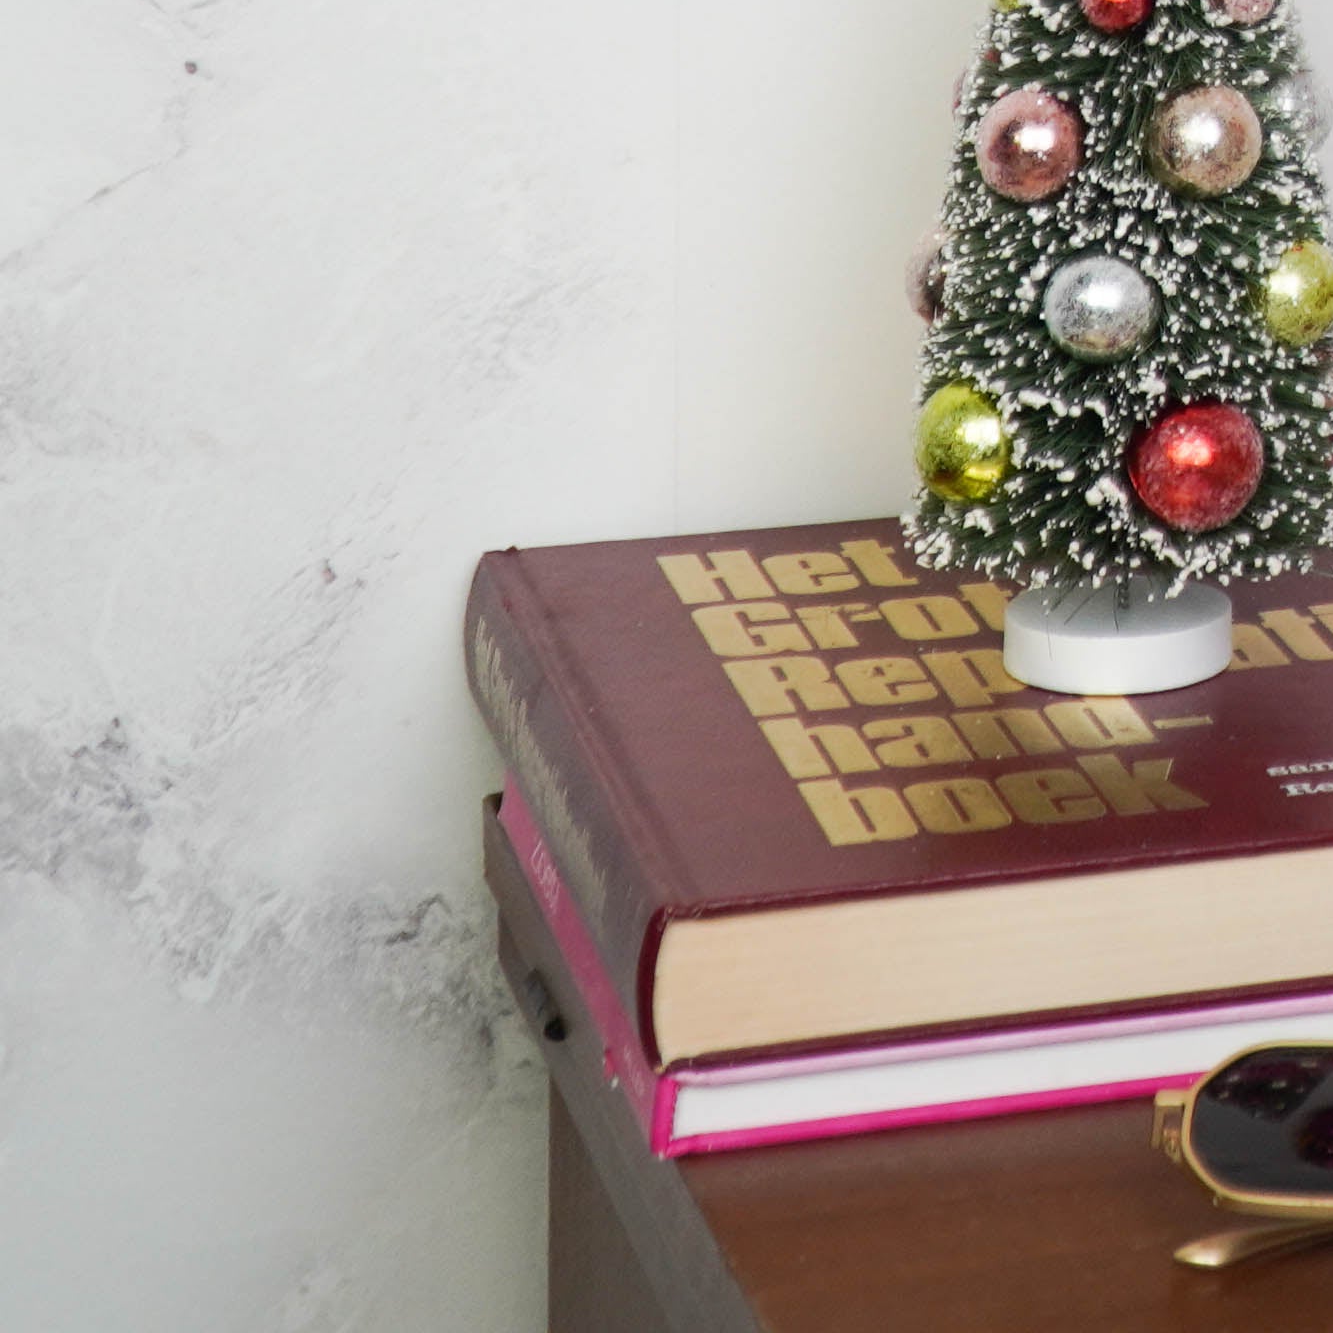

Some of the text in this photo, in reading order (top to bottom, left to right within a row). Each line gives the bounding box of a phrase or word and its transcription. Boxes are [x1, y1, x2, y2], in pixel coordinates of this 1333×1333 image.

[656, 539, 918, 605] Het
[691, 582, 1013, 658] Grot
[758, 696, 1214, 780] hand-
[798, 753, 1210, 847] boek
